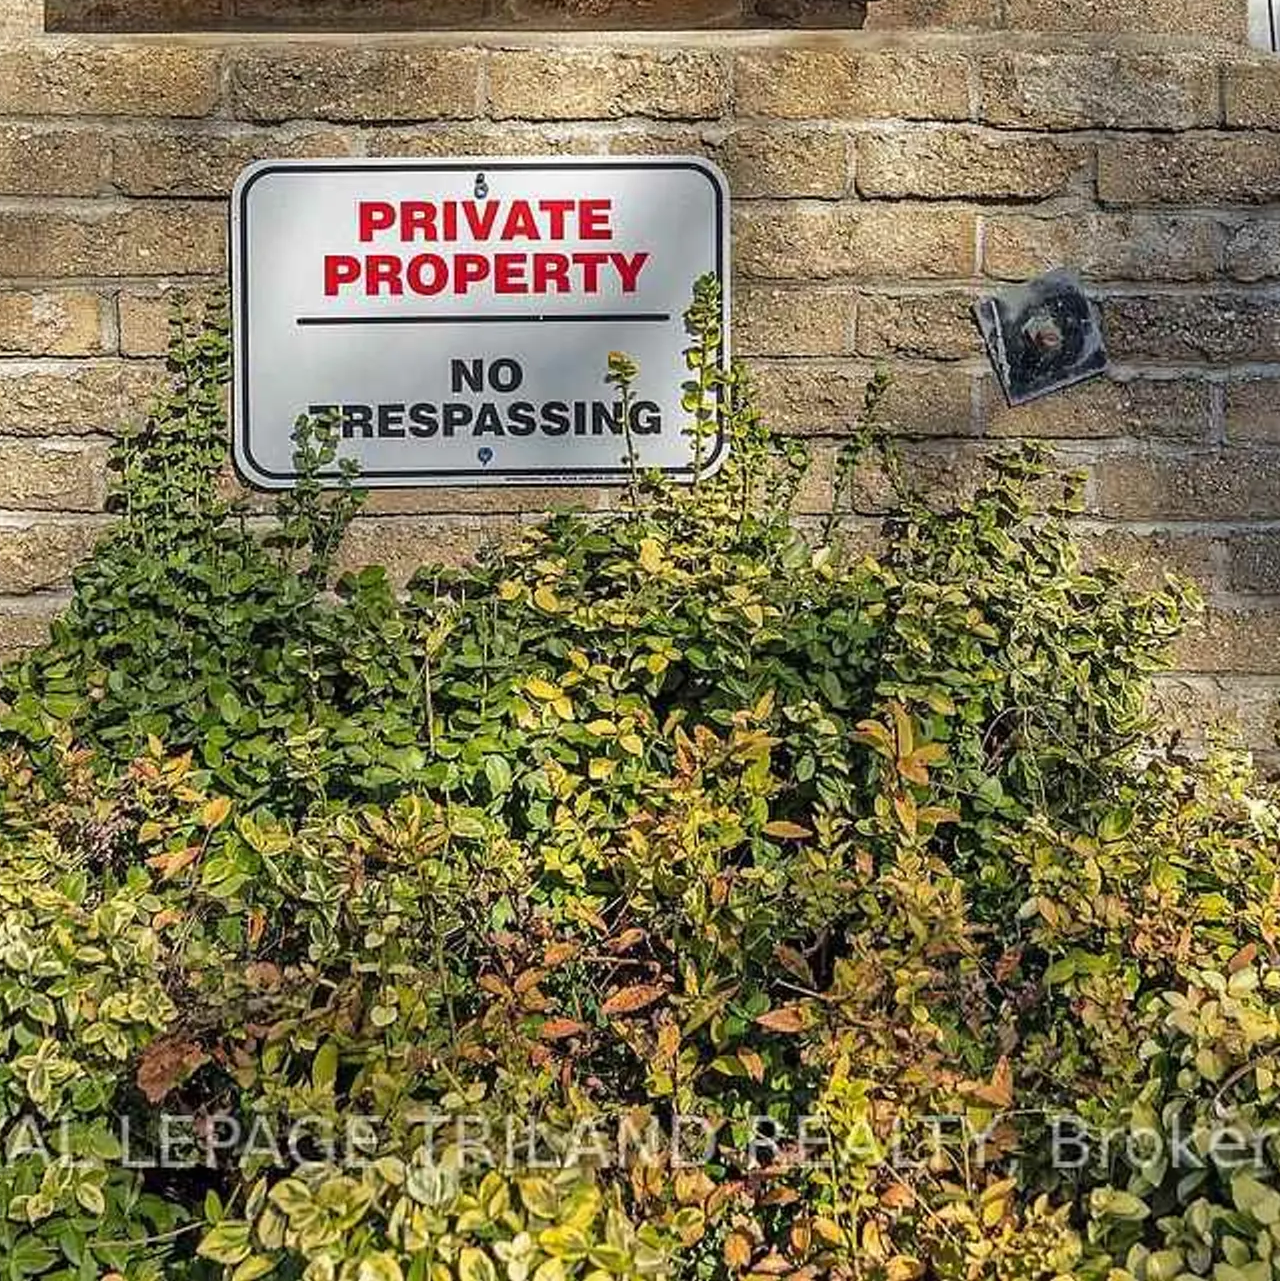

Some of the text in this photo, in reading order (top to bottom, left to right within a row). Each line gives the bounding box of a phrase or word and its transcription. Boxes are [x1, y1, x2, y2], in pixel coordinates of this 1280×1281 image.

[357, 198, 614, 243] PRIVATE
[322, 251, 651, 297] PROPERTY
[449, 357, 524, 393] NO
